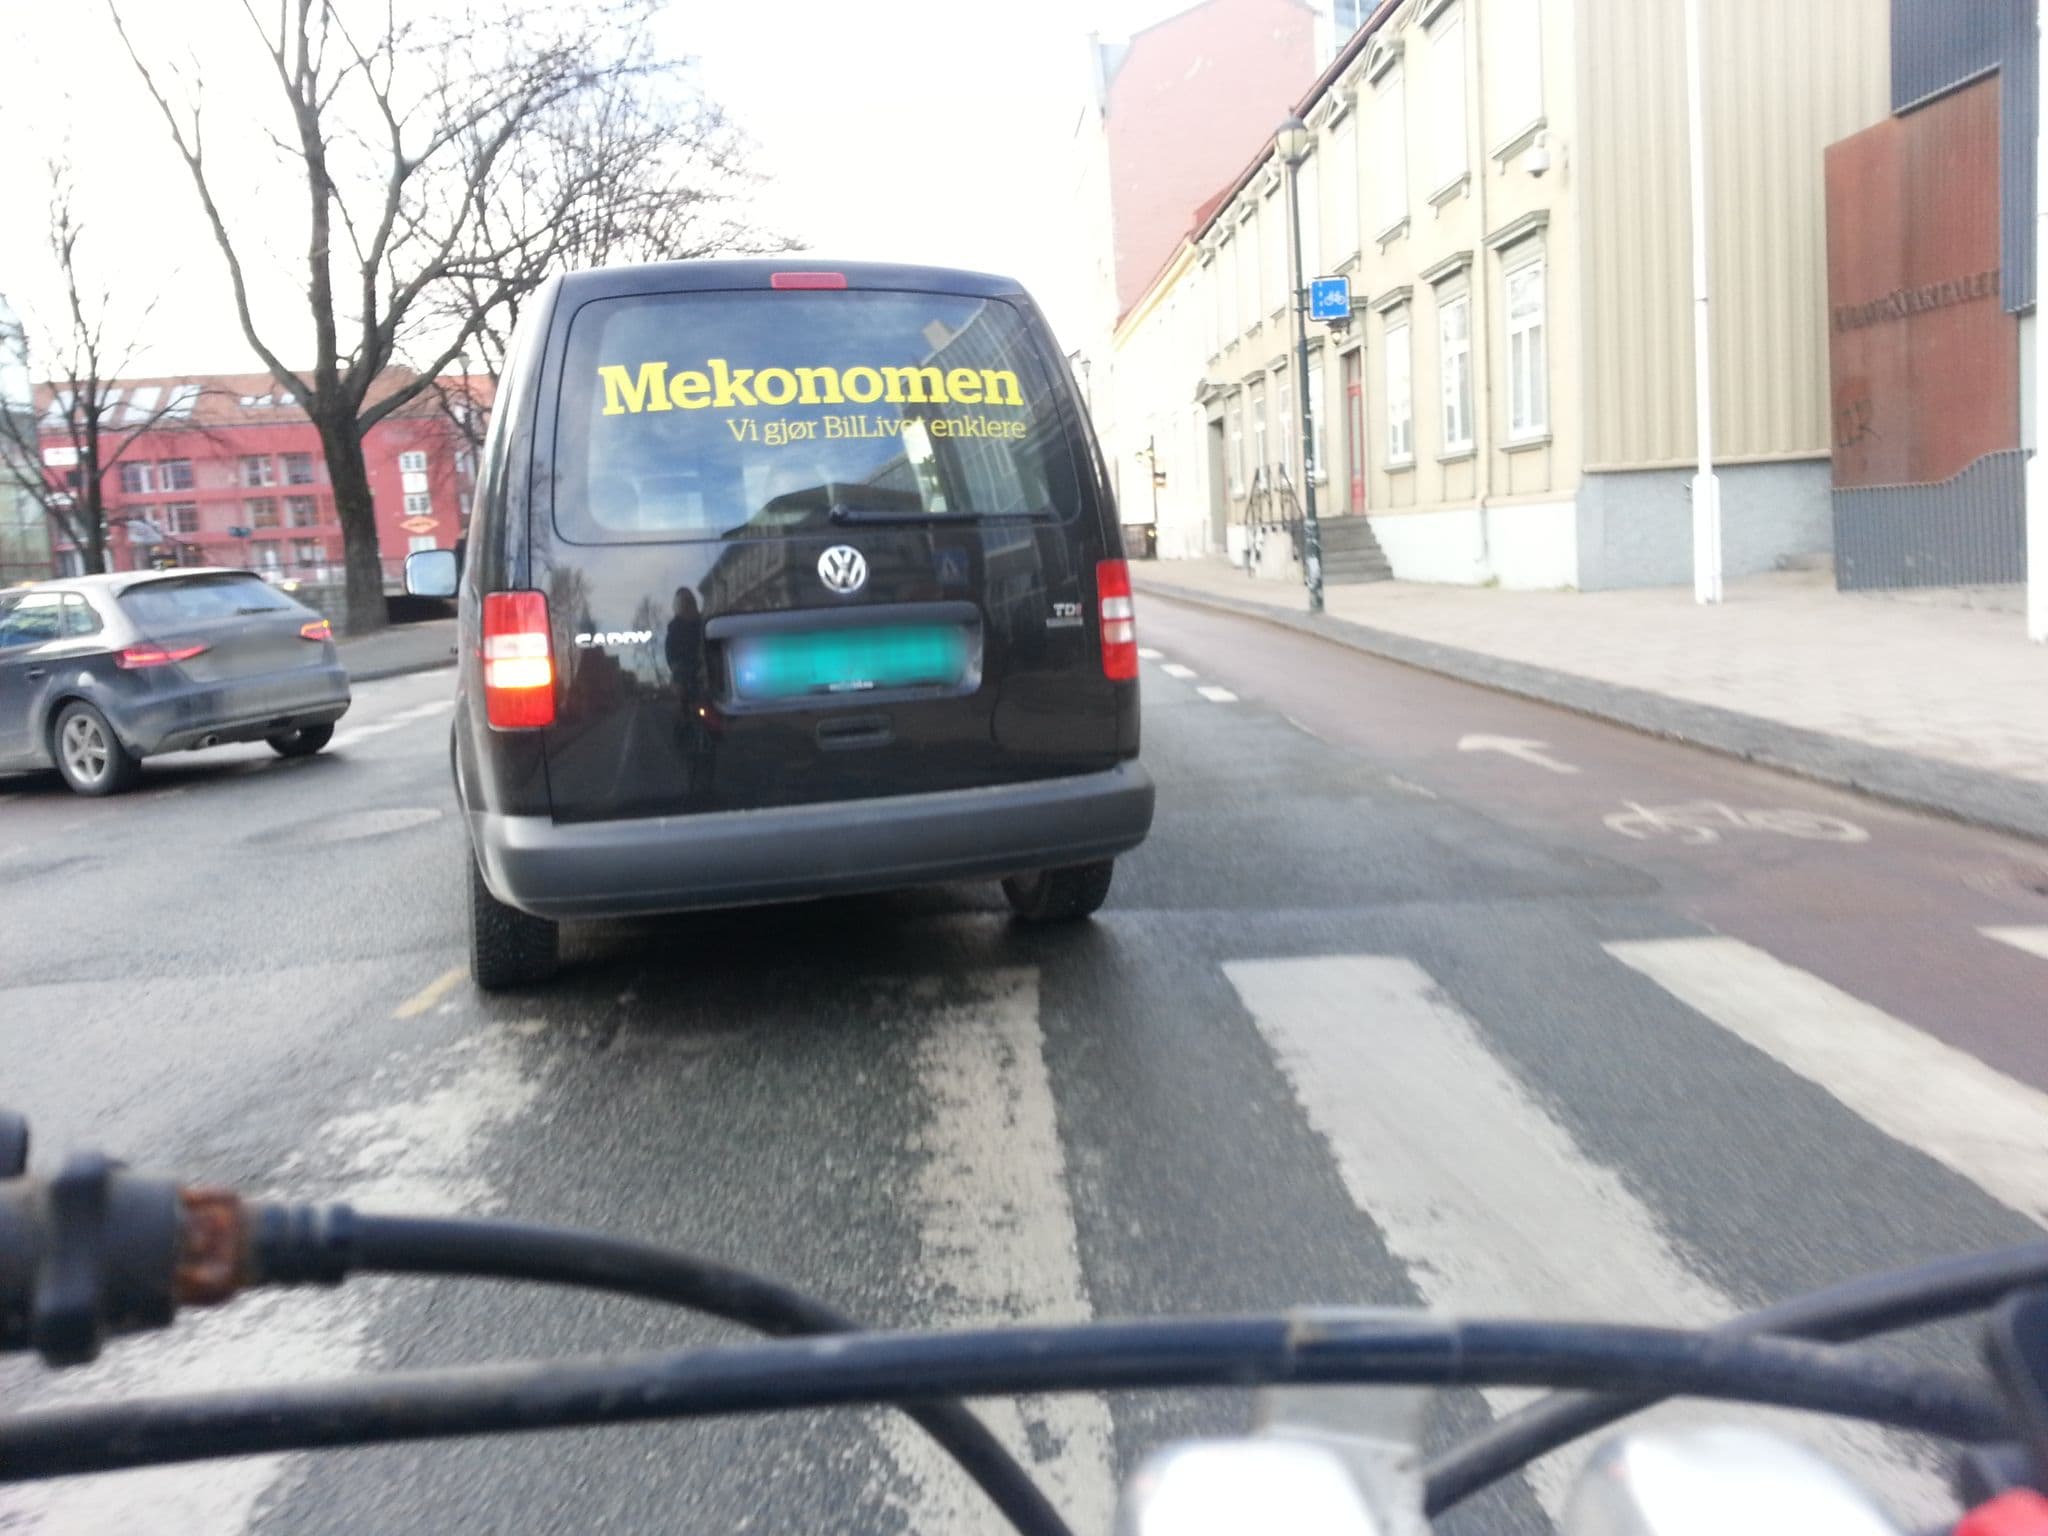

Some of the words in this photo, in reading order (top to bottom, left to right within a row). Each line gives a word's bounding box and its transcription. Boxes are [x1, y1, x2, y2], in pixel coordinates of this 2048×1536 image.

[598, 358, 1024, 416] Mekonomen
[726, 418, 759, 442] Vi
[764, 418, 818, 446] gjør
[930, 415, 1026, 439] enklere
[1053, 602, 1082, 617] TDI
